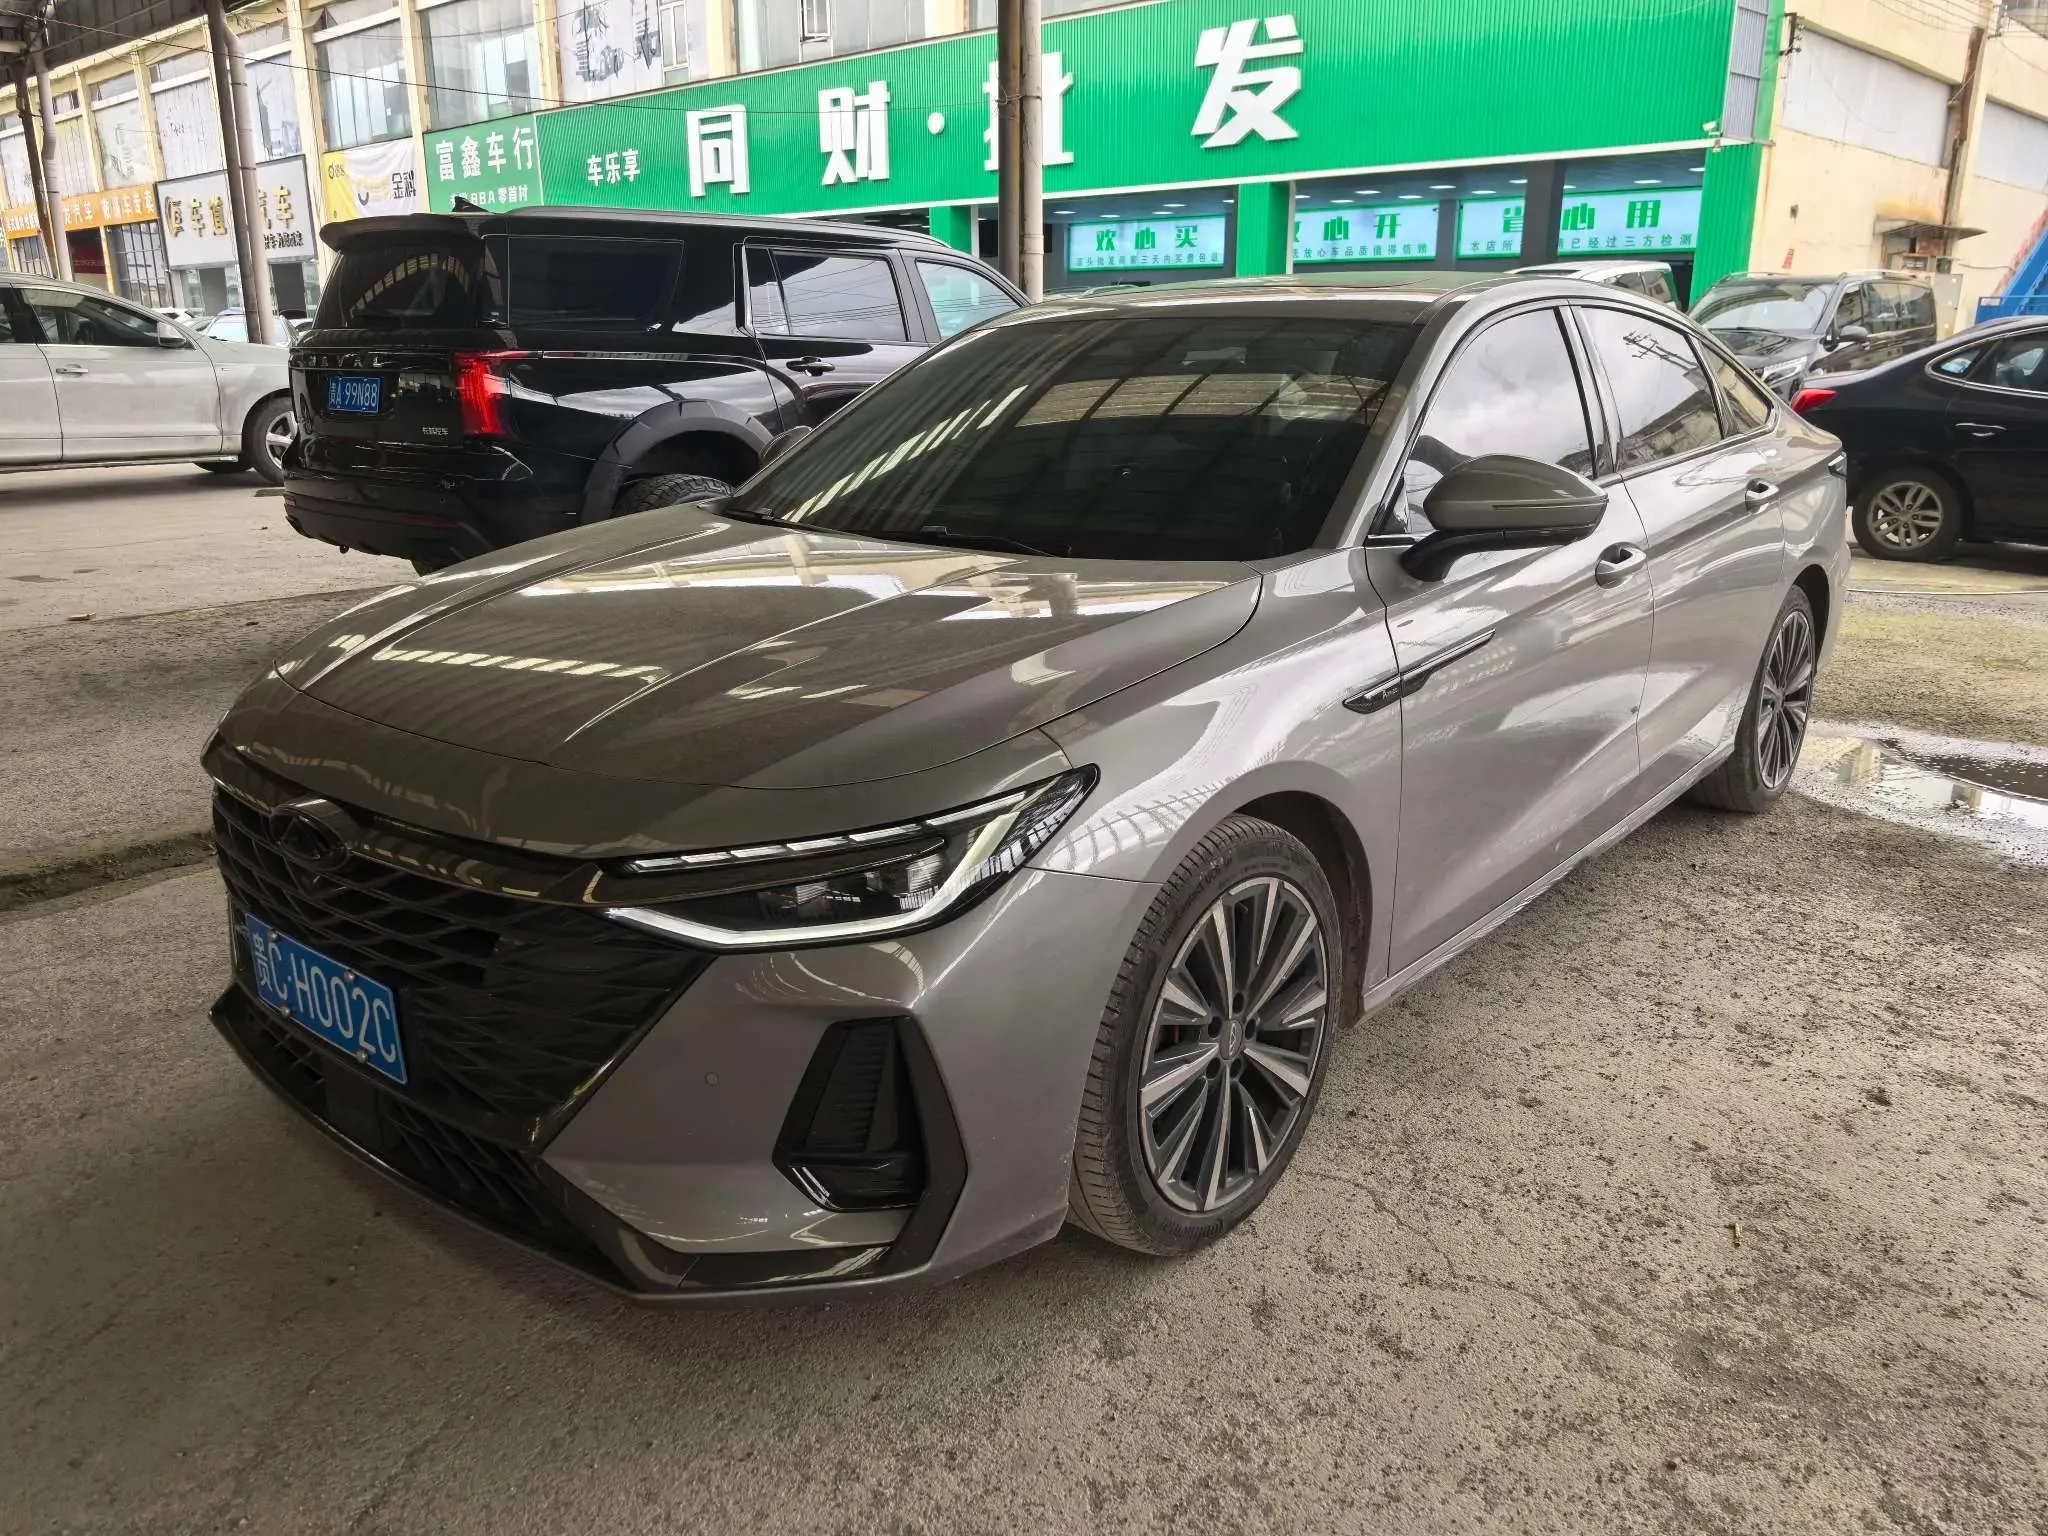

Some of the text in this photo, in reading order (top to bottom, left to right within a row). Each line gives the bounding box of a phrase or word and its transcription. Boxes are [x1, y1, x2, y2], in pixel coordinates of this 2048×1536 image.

[435, 127, 534, 182] 富鑫车行
[587, 149, 641, 187] 车乐享
[1096, 225, 1198, 252] 欢心买
[1294, 213, 1401, 243] 心开
